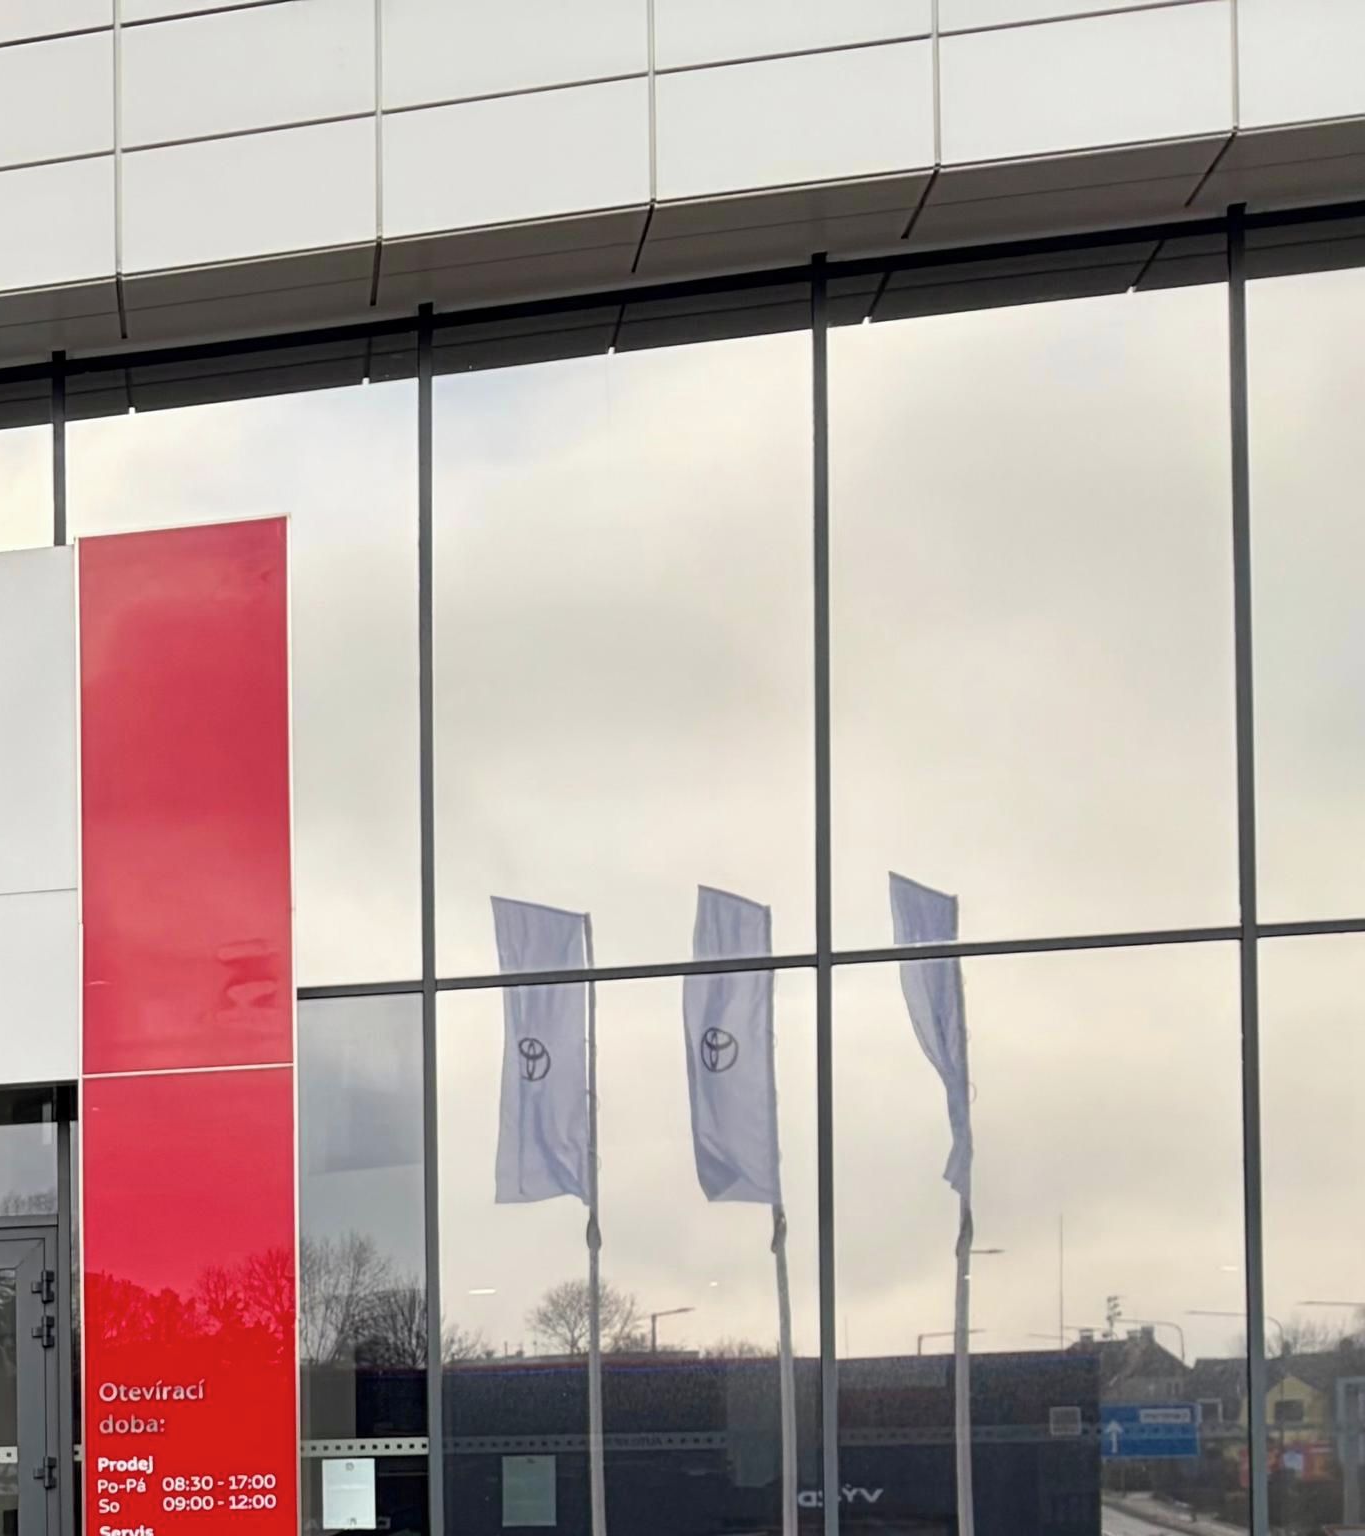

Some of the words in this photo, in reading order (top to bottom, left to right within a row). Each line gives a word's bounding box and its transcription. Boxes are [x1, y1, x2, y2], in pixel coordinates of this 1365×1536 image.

[99, 1379, 205, 1401] Otevírací
[99, 1414, 165, 1433] doba:
[97, 1456, 154, 1474] Prodej
[97, 1478, 146, 1493] Po-Pá
[162, 1475, 214, 1491] 08:30
[228, 1474, 276, 1490] 17:00
[98, 1498, 120, 1513] So
[162, 1496, 214, 1511] 09:00
[228, 1494, 277, 1509] 12:00
